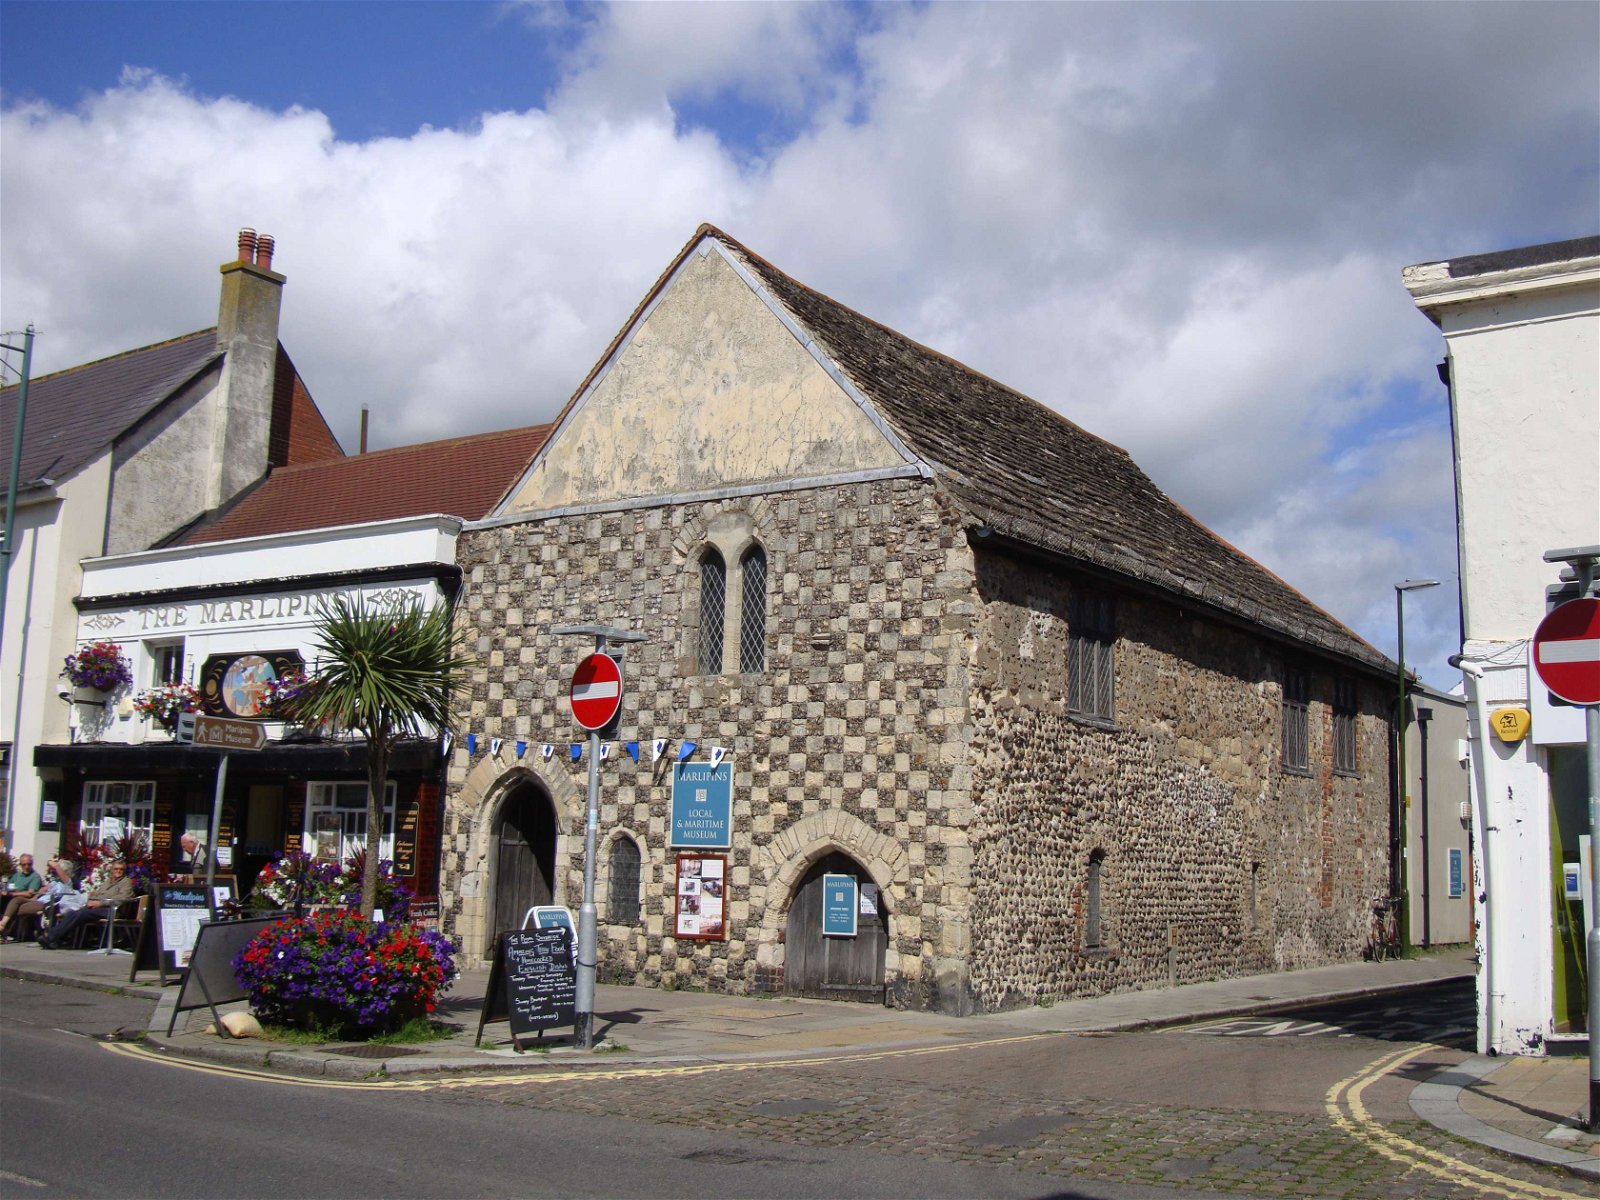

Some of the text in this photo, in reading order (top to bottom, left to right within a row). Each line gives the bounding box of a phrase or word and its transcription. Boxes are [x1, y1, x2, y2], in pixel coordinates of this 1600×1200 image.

[138, 606, 188, 629] THE
[225, 734, 252, 744] Museum
[677, 771, 728, 781] MARLIPINS
[688, 809, 713, 818] LOCAL
[676, 820, 724, 829] & MARITIME
[683, 831, 717, 839] MUSEUM
